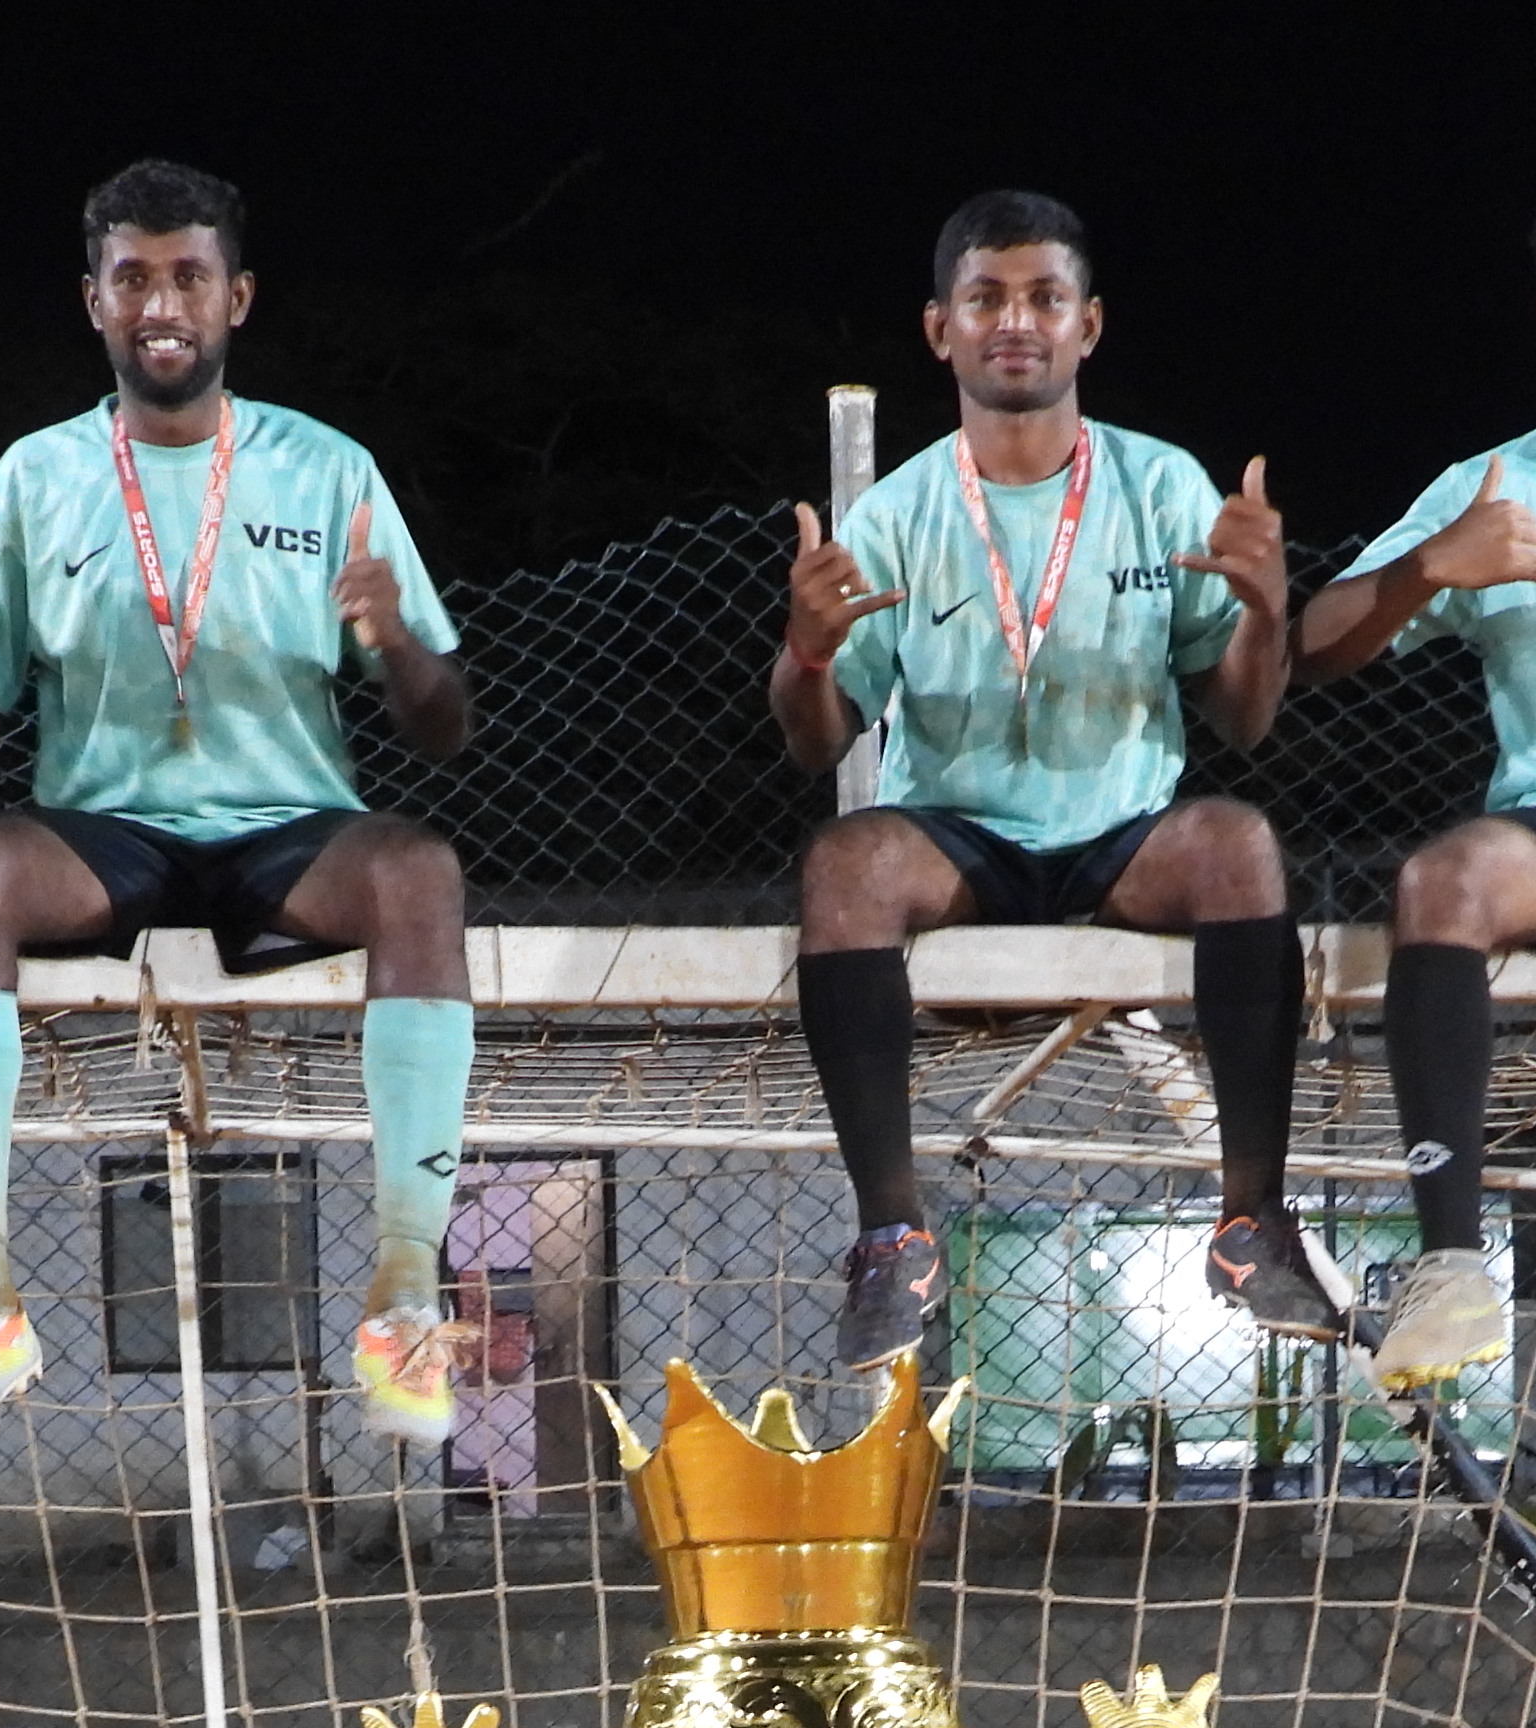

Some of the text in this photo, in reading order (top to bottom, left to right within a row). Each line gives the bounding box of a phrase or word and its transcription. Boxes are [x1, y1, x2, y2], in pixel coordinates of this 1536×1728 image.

[131, 511, 164, 597] SPORTS
[242, 523, 322, 555] VCS
[1043, 518, 1076, 602] SPORTS
